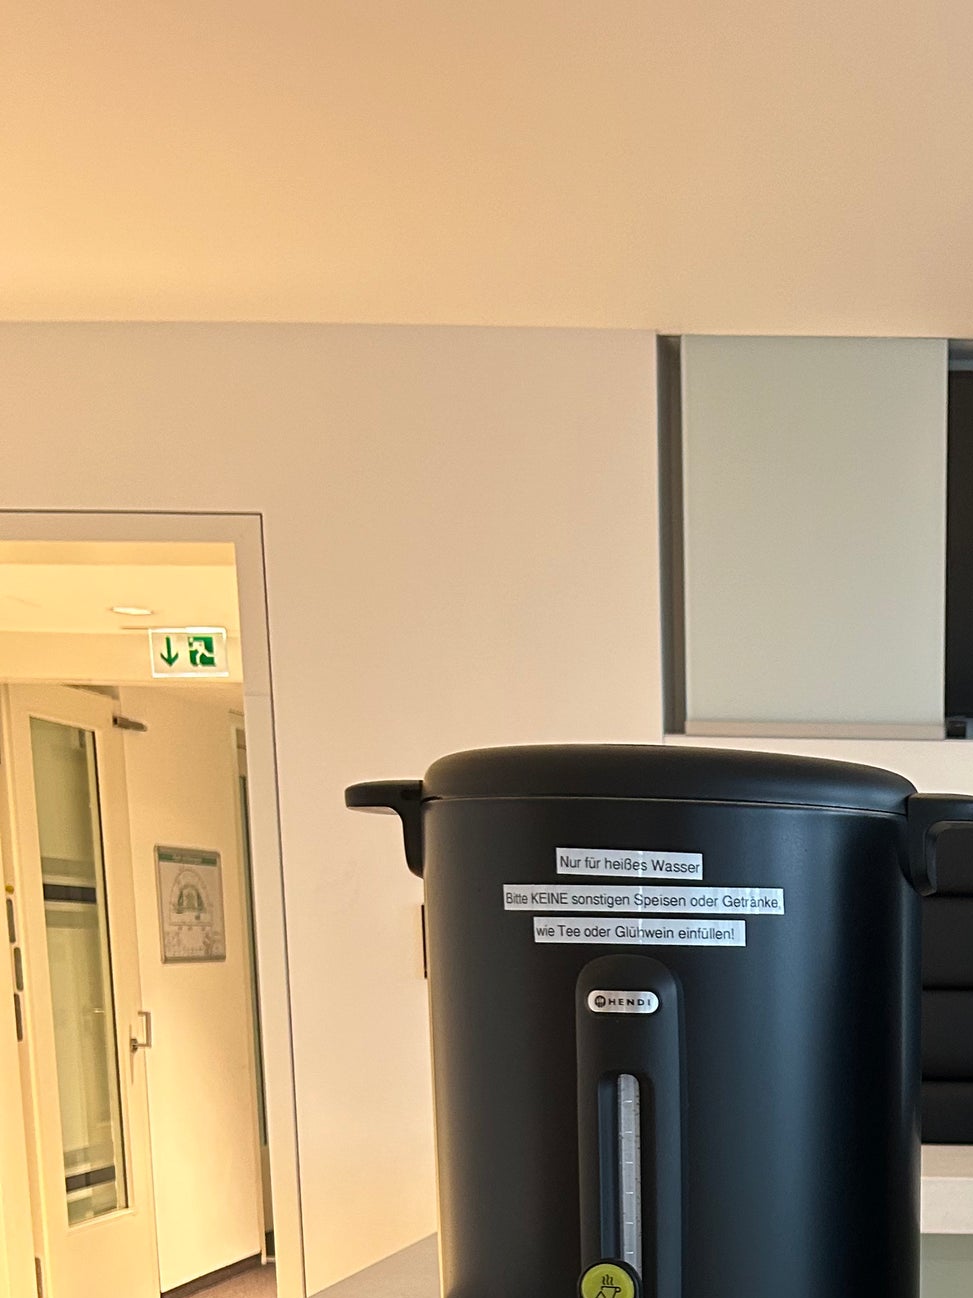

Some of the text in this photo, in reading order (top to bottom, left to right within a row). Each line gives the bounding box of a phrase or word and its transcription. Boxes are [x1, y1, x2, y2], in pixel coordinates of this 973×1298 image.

[560, 856, 700, 874] Nur für heißes Wasser
[505, 892, 528, 905] Bitte
[531, 892, 568, 905] KEINE
[572, 894, 630, 909] sonstigen
[634, 894, 686, 910] Speisen
[690, 895, 717, 908] oder
[536, 925, 734, 940] wie Tee oder Glühwein einfüllen!
[608, 998, 651, 1007] HENDI
